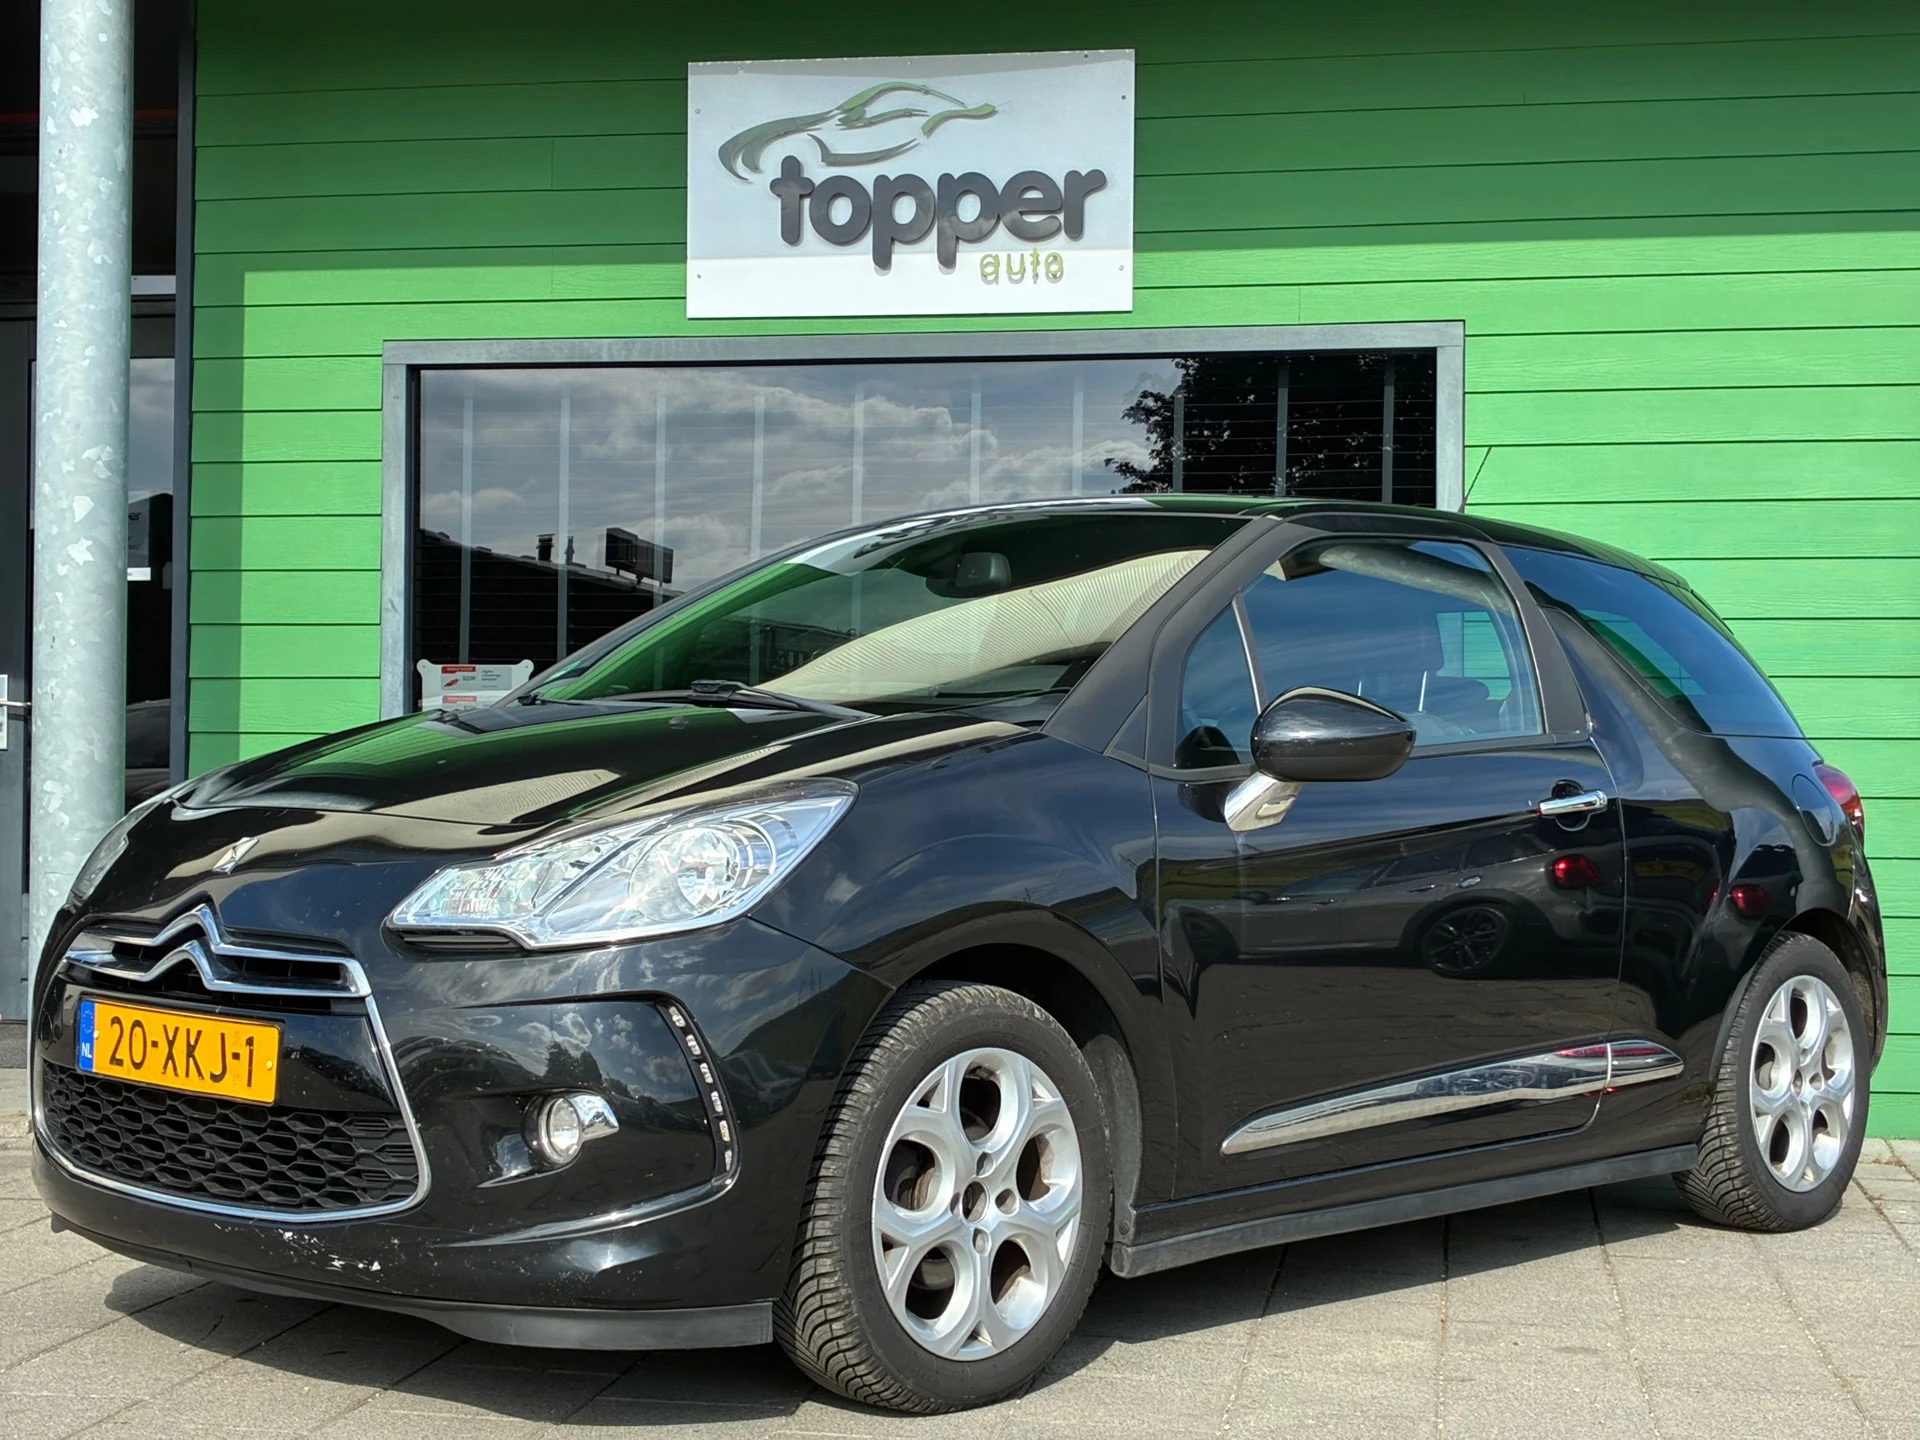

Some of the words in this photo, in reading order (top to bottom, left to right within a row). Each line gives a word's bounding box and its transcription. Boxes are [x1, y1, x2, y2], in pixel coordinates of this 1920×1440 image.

[769, 155, 1107, 271] topper
[980, 245, 1064, 279] auto
[81, 1041, 92, 1058] NL
[109, 1016, 254, 1087] 20-XKJ-1
